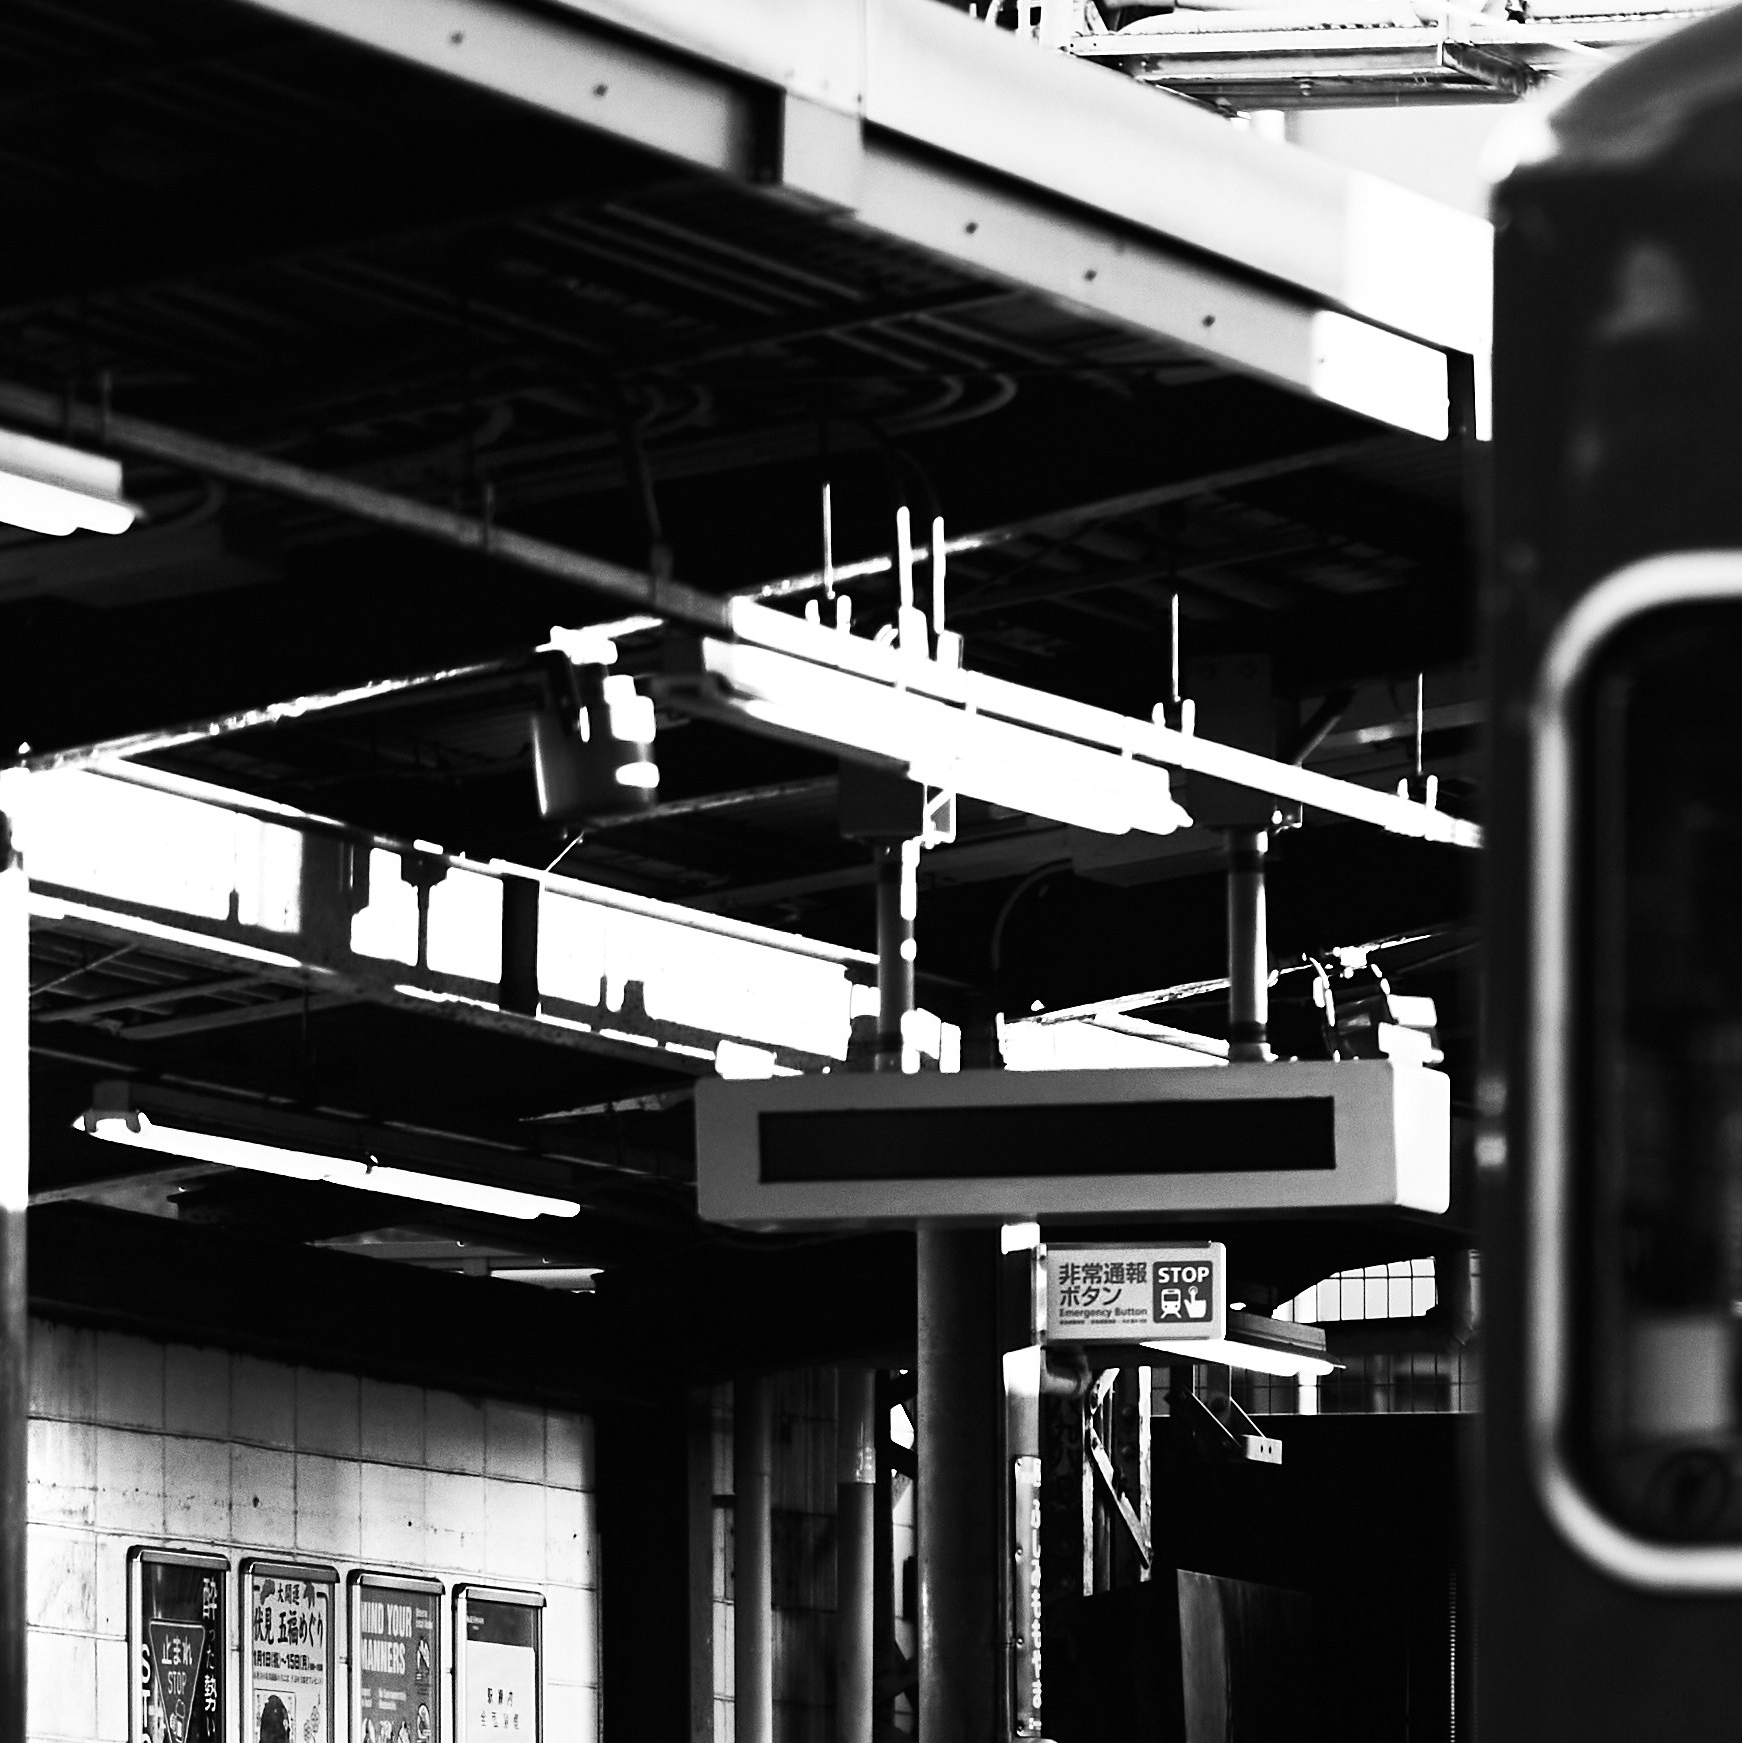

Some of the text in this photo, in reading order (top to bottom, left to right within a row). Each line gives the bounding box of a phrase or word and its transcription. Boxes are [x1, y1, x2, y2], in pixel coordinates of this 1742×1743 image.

[1058, 1262, 1148, 1285] 非常通報
[1158, 1266, 1210, 1283] STOP
[1059, 1284, 1123, 1307] ボタン
[1059, 1307, 1148, 1319] Emergency Button
[386, 1603, 412, 1638] YOUR
[161, 1633, 193, 1666] 止まれ
[167, 1670, 187, 1695] STOP
